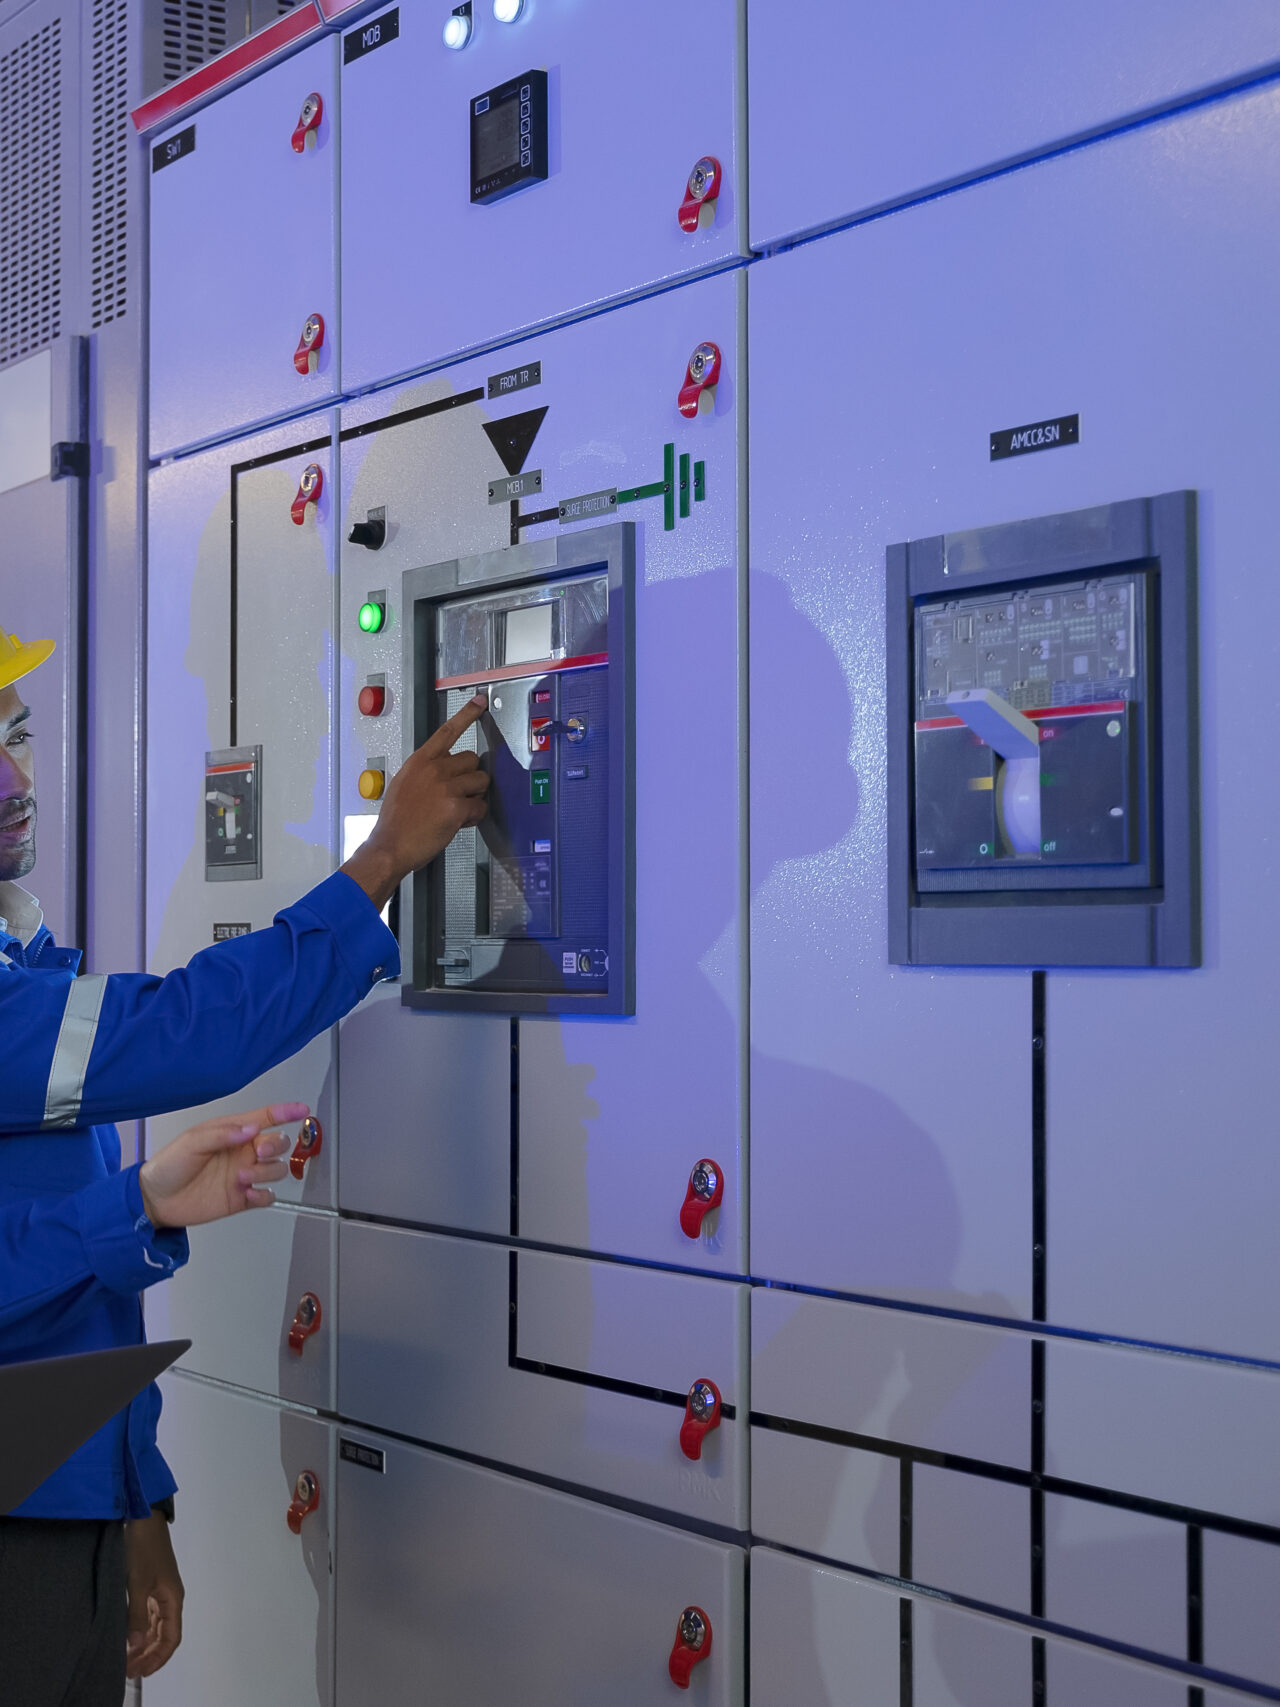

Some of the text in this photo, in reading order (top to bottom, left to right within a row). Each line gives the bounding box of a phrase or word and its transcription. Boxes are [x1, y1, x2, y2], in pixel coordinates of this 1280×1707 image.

[362, 24, 380, 49] MDB
[500, 370, 529, 391] FROM TR
[1010, 424, 1060, 450] AMCC&SN
[582, 495, 610, 512] PROTECTION
[1042, 729, 1054, 738] on
[1043, 841, 1056, 852] off
